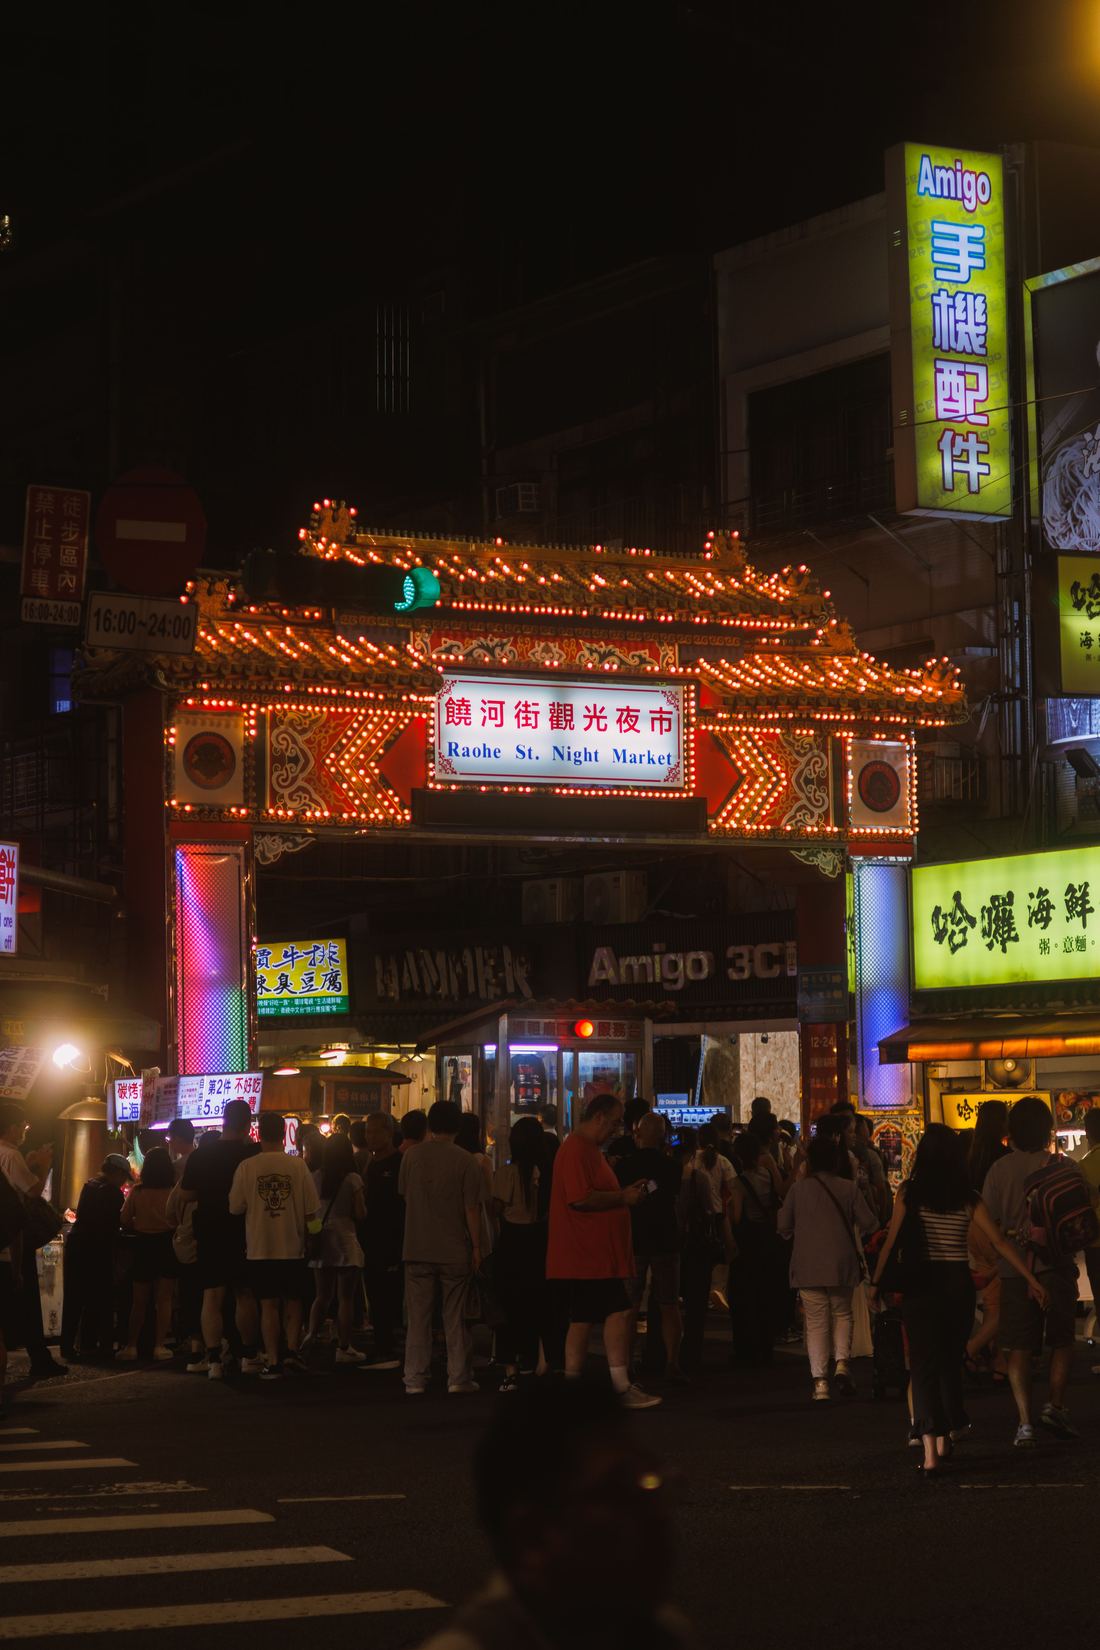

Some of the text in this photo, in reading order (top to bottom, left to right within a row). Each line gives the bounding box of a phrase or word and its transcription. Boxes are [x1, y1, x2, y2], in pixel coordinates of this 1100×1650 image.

[917, 154, 992, 213] Amigo
[931, 220, 991, 494] 手機配件
[31, 493, 56, 595] 禁止停車
[57, 496, 82, 593] 徒步區內
[94, 608, 192, 640] 16:00~24:00
[1080, 630, 1100, 650] 海
[444, 696, 675, 736] 饒河街觀光夜市
[447, 741, 673, 766] Raohe St. Night Market
[588, 942, 714, 991] Amigo
[118, 1082, 145, 1099] 碳烤
[208, 1079, 232, 1096] 第2件
[234, 1077, 262, 1094] 不好吃
